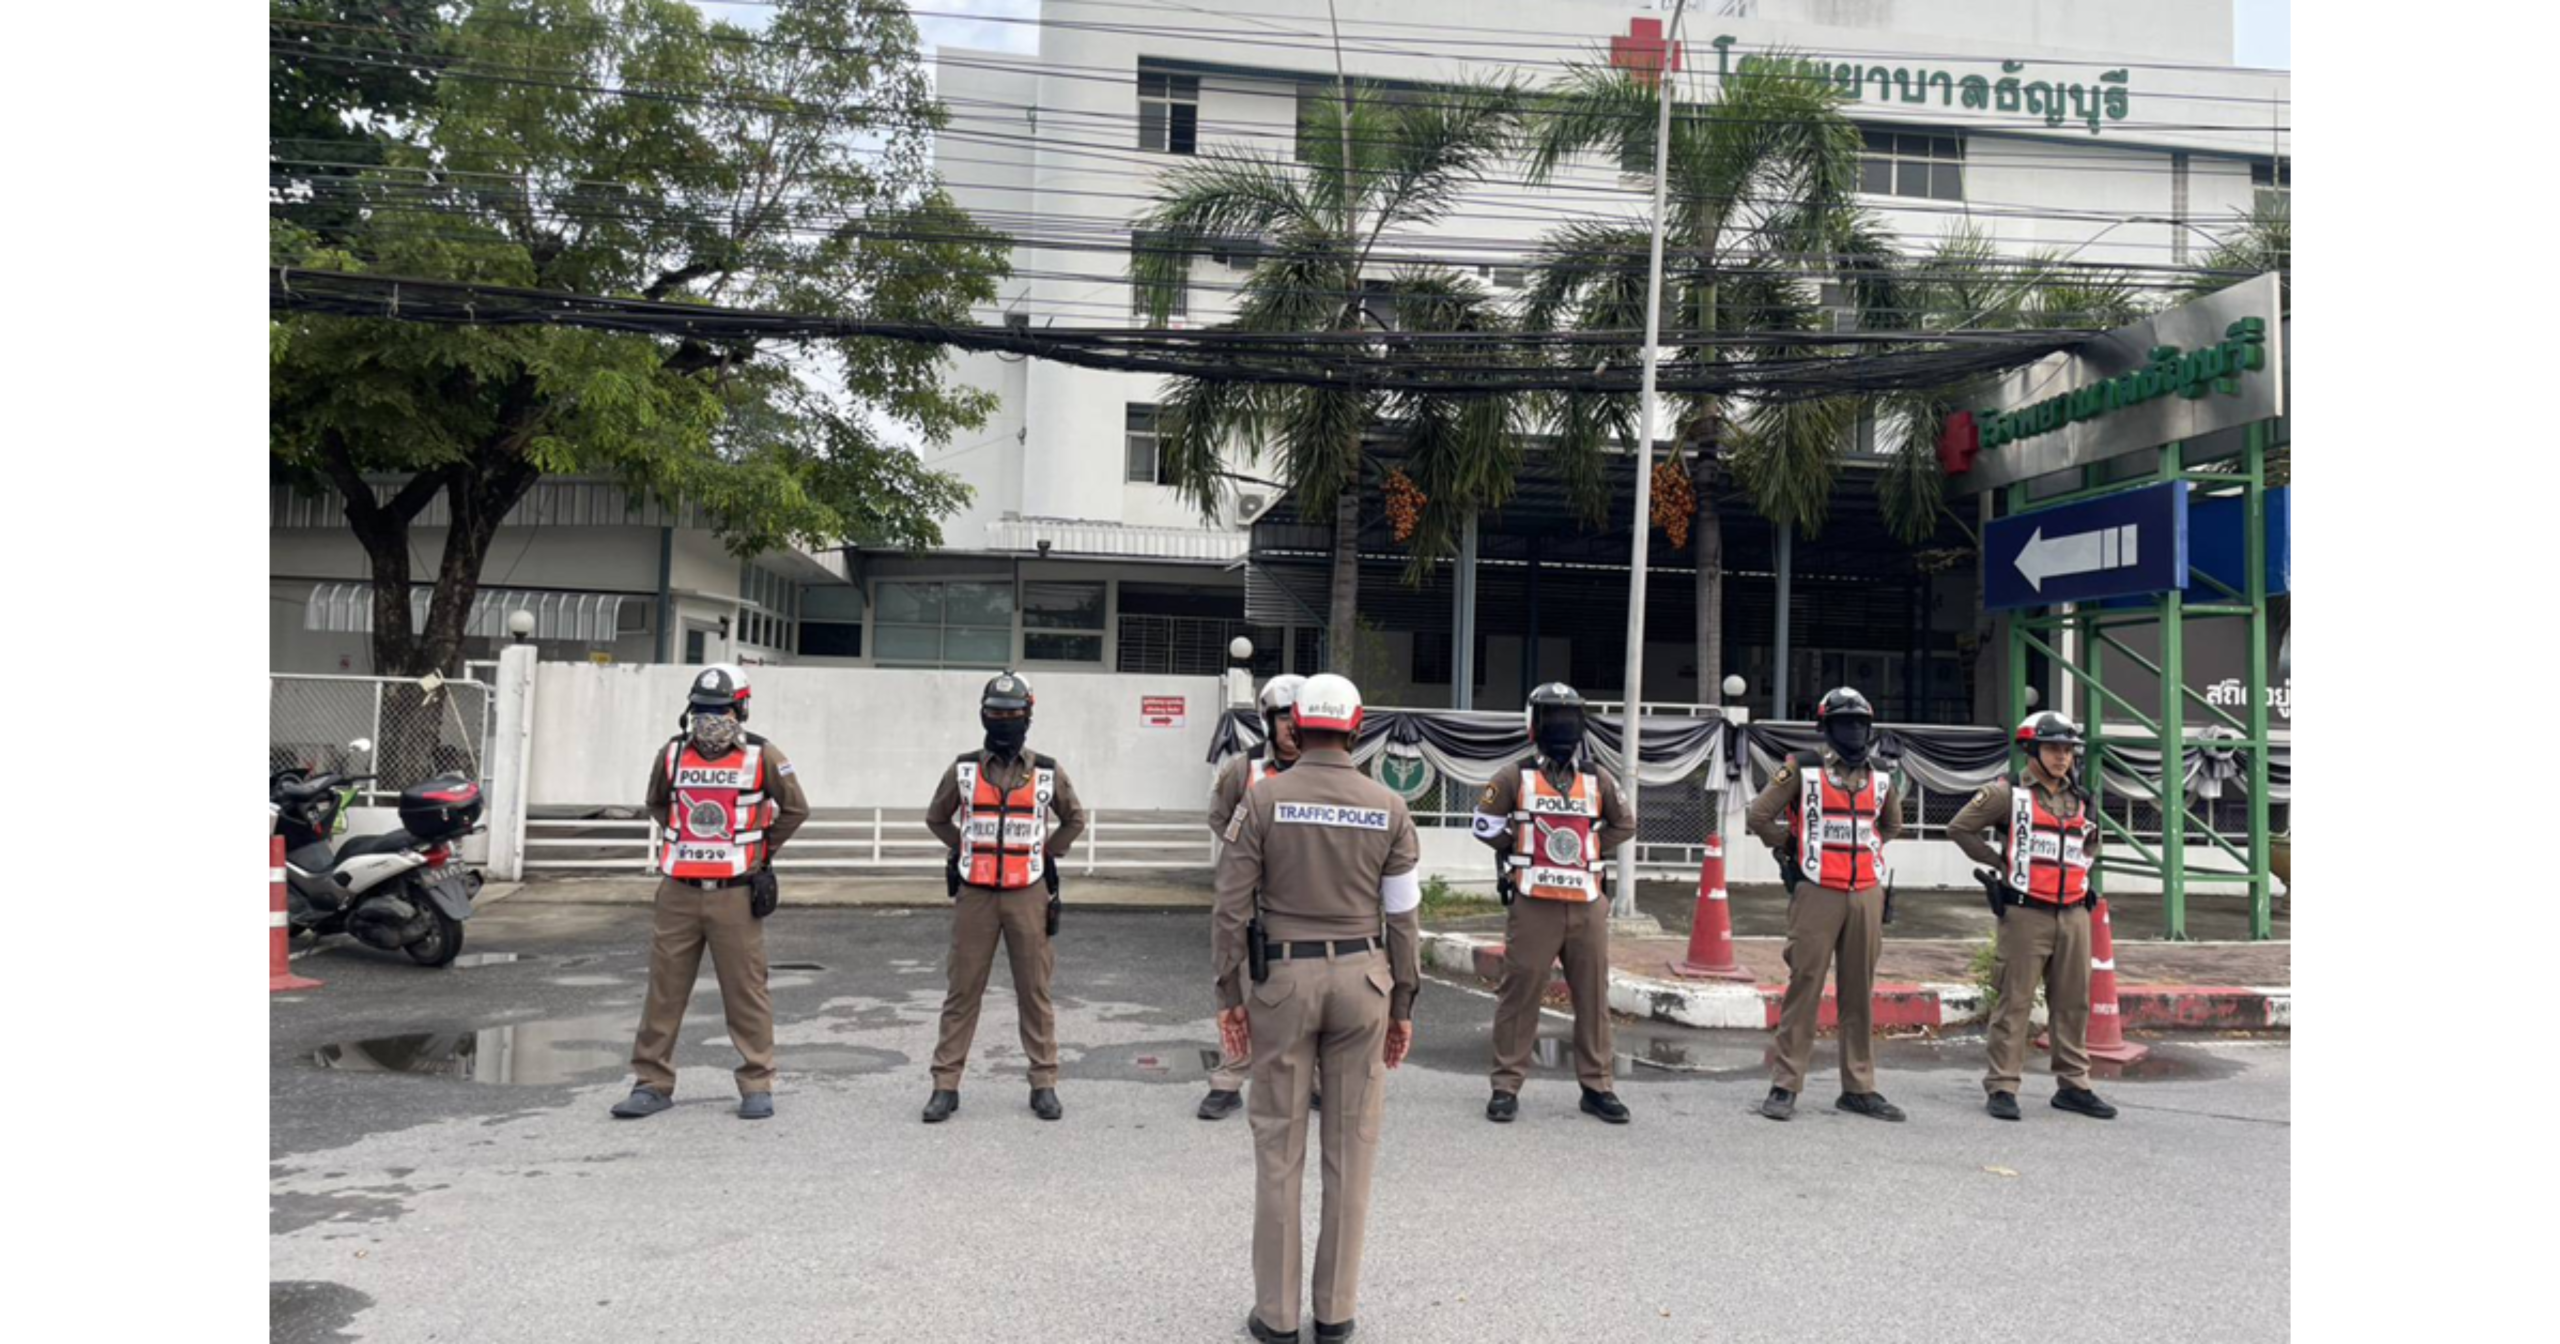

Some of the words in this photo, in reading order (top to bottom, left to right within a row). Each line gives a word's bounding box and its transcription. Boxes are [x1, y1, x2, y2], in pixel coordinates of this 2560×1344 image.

[1711, 34, 2130, 135] โพยาบาลธัญบุรี
[679, 770, 739, 784] POLICE
[1279, 805, 1335, 822] TRAFFIC
[1338, 809, 1387, 827] POLICE
[1030, 774, 1051, 872] POLICE
[1805, 780, 1819, 871] TRAFFIC
[2014, 798, 2030, 886] TRAFFIC
[1537, 869, 1583, 886] ตำรวจ
